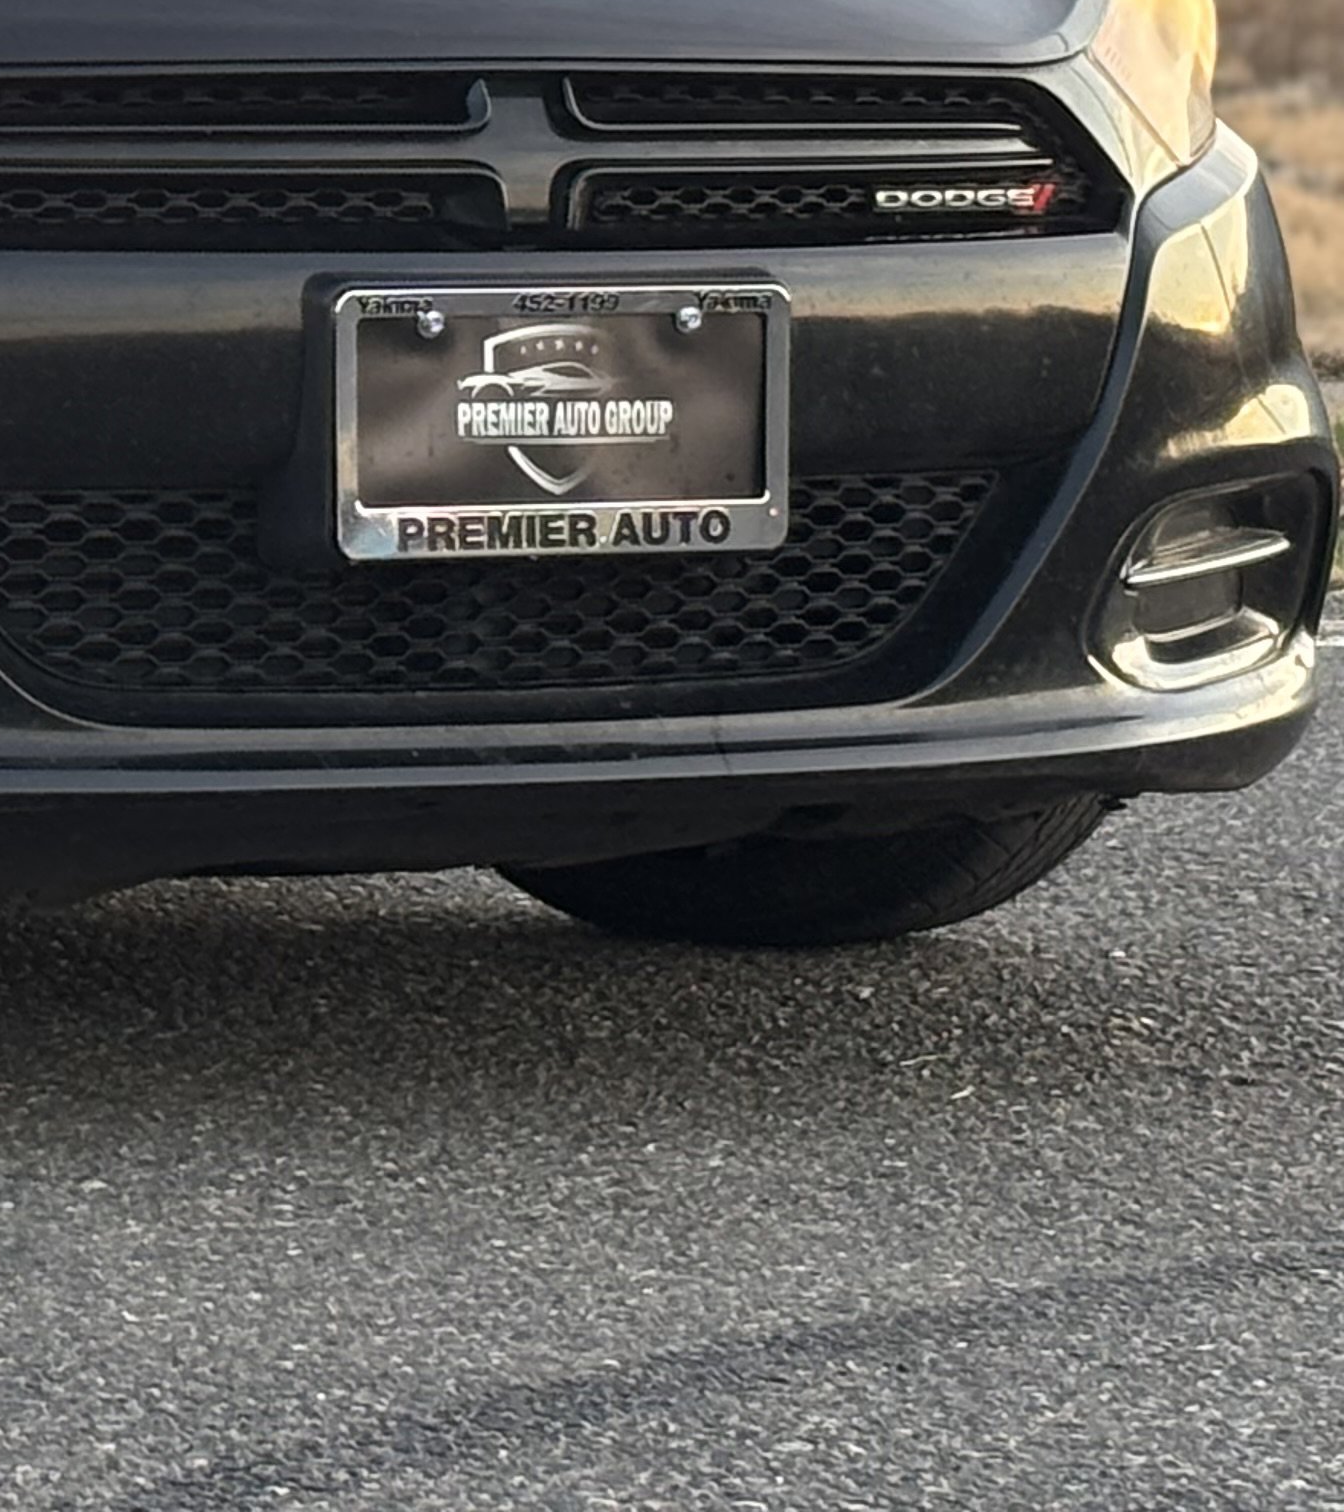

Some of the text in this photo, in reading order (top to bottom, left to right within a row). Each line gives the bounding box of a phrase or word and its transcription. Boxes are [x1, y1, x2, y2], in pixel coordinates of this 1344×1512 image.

[875, 189, 1035, 208] DODGE
[457, 399, 673, 437] PREMIER AUTO GROUP
[397, 509, 732, 552] PREMIER AUTO
